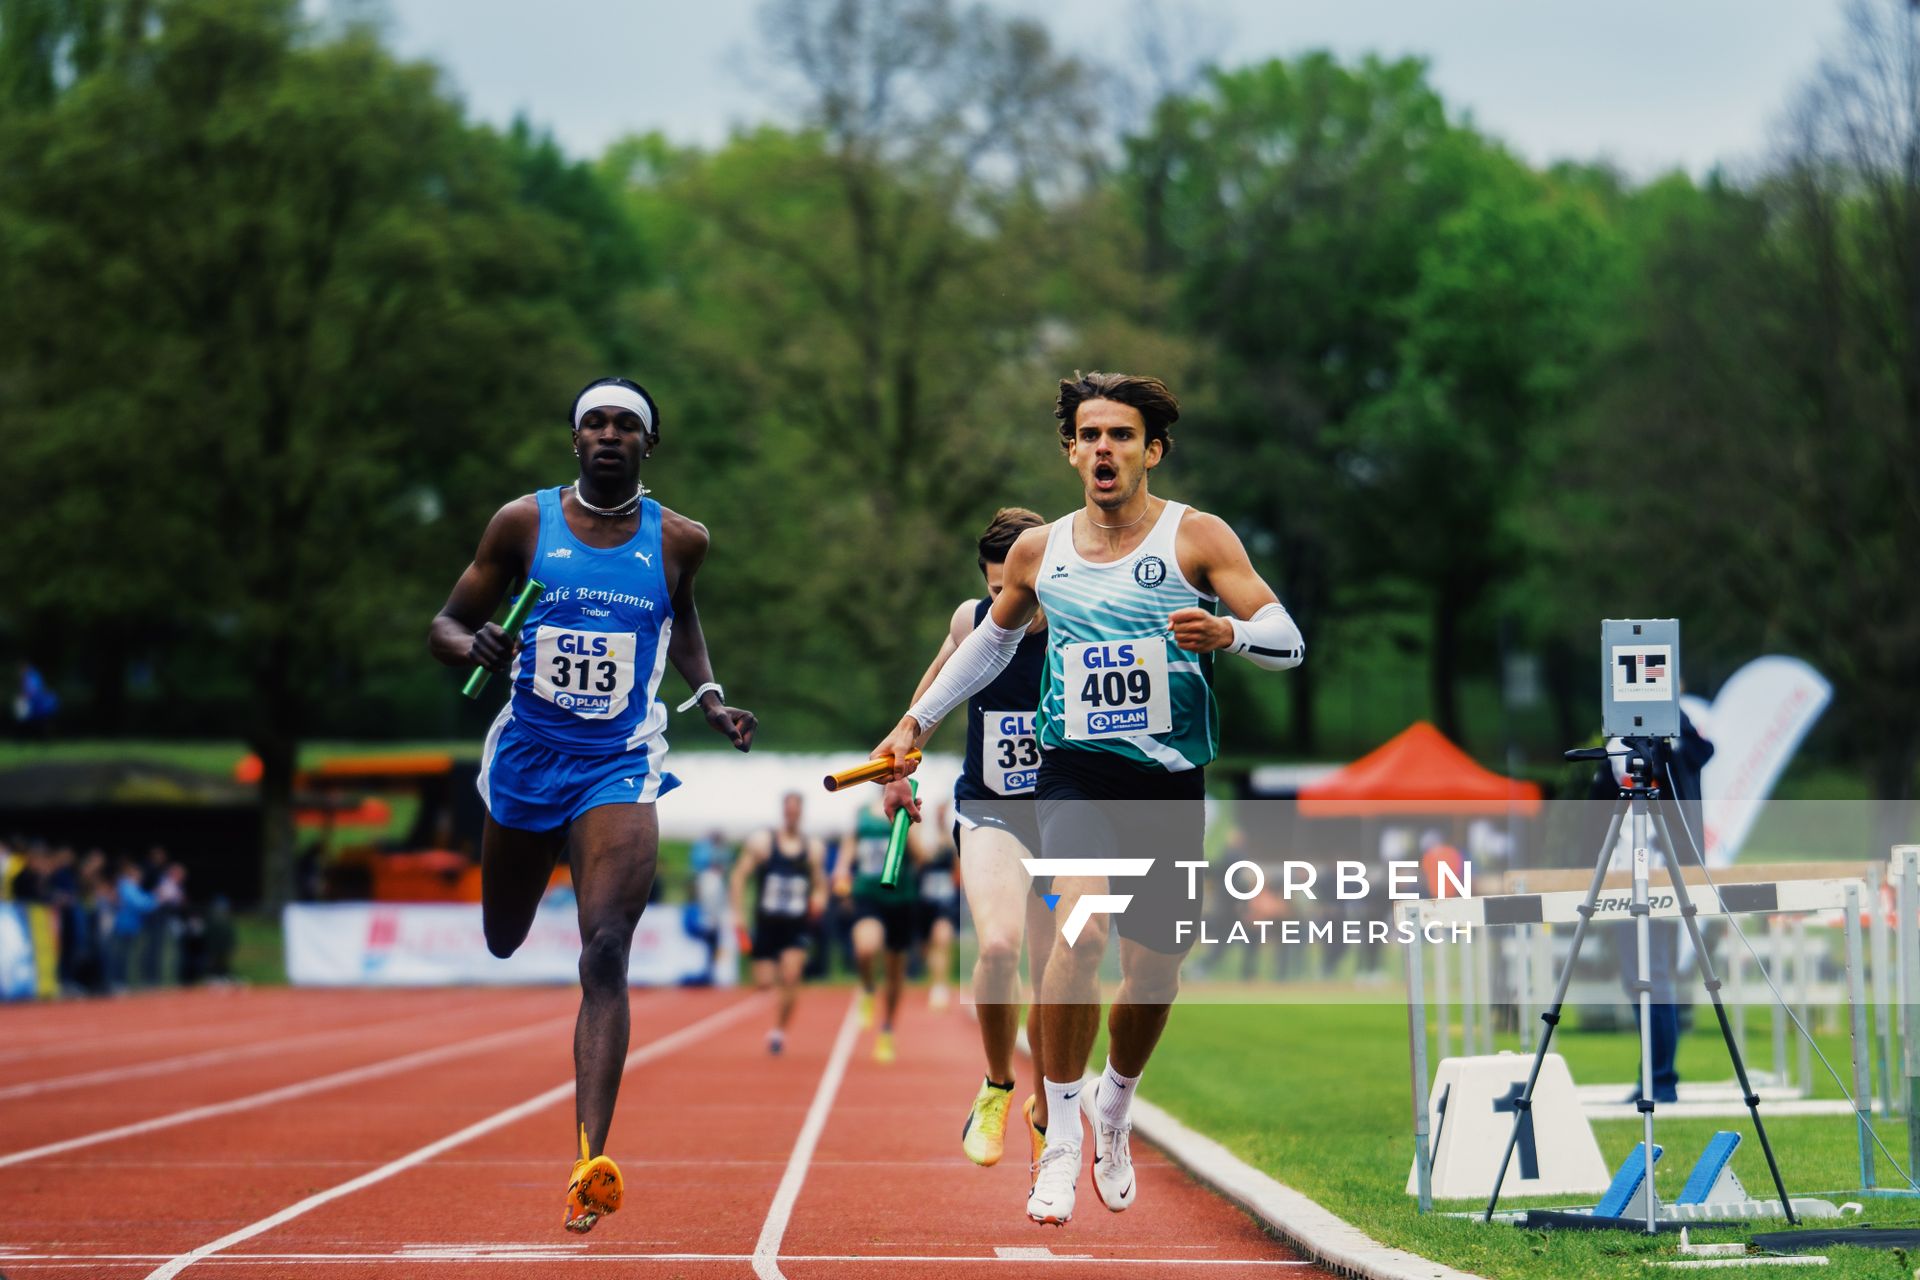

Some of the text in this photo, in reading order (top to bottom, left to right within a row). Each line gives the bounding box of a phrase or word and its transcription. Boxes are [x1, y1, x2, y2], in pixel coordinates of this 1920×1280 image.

[576, 587, 654, 611] Benjamin
[581, 607, 611, 617] Trebur
[551, 656, 617, 692] 313
[1081, 669, 1151, 707] 409
[577, 698, 608, 708] PLAN
[1112, 712, 1145, 724] PLAN
[1593, 896, 1673, 912] ERHRD
[1492, 1081, 1540, 1180] 1
